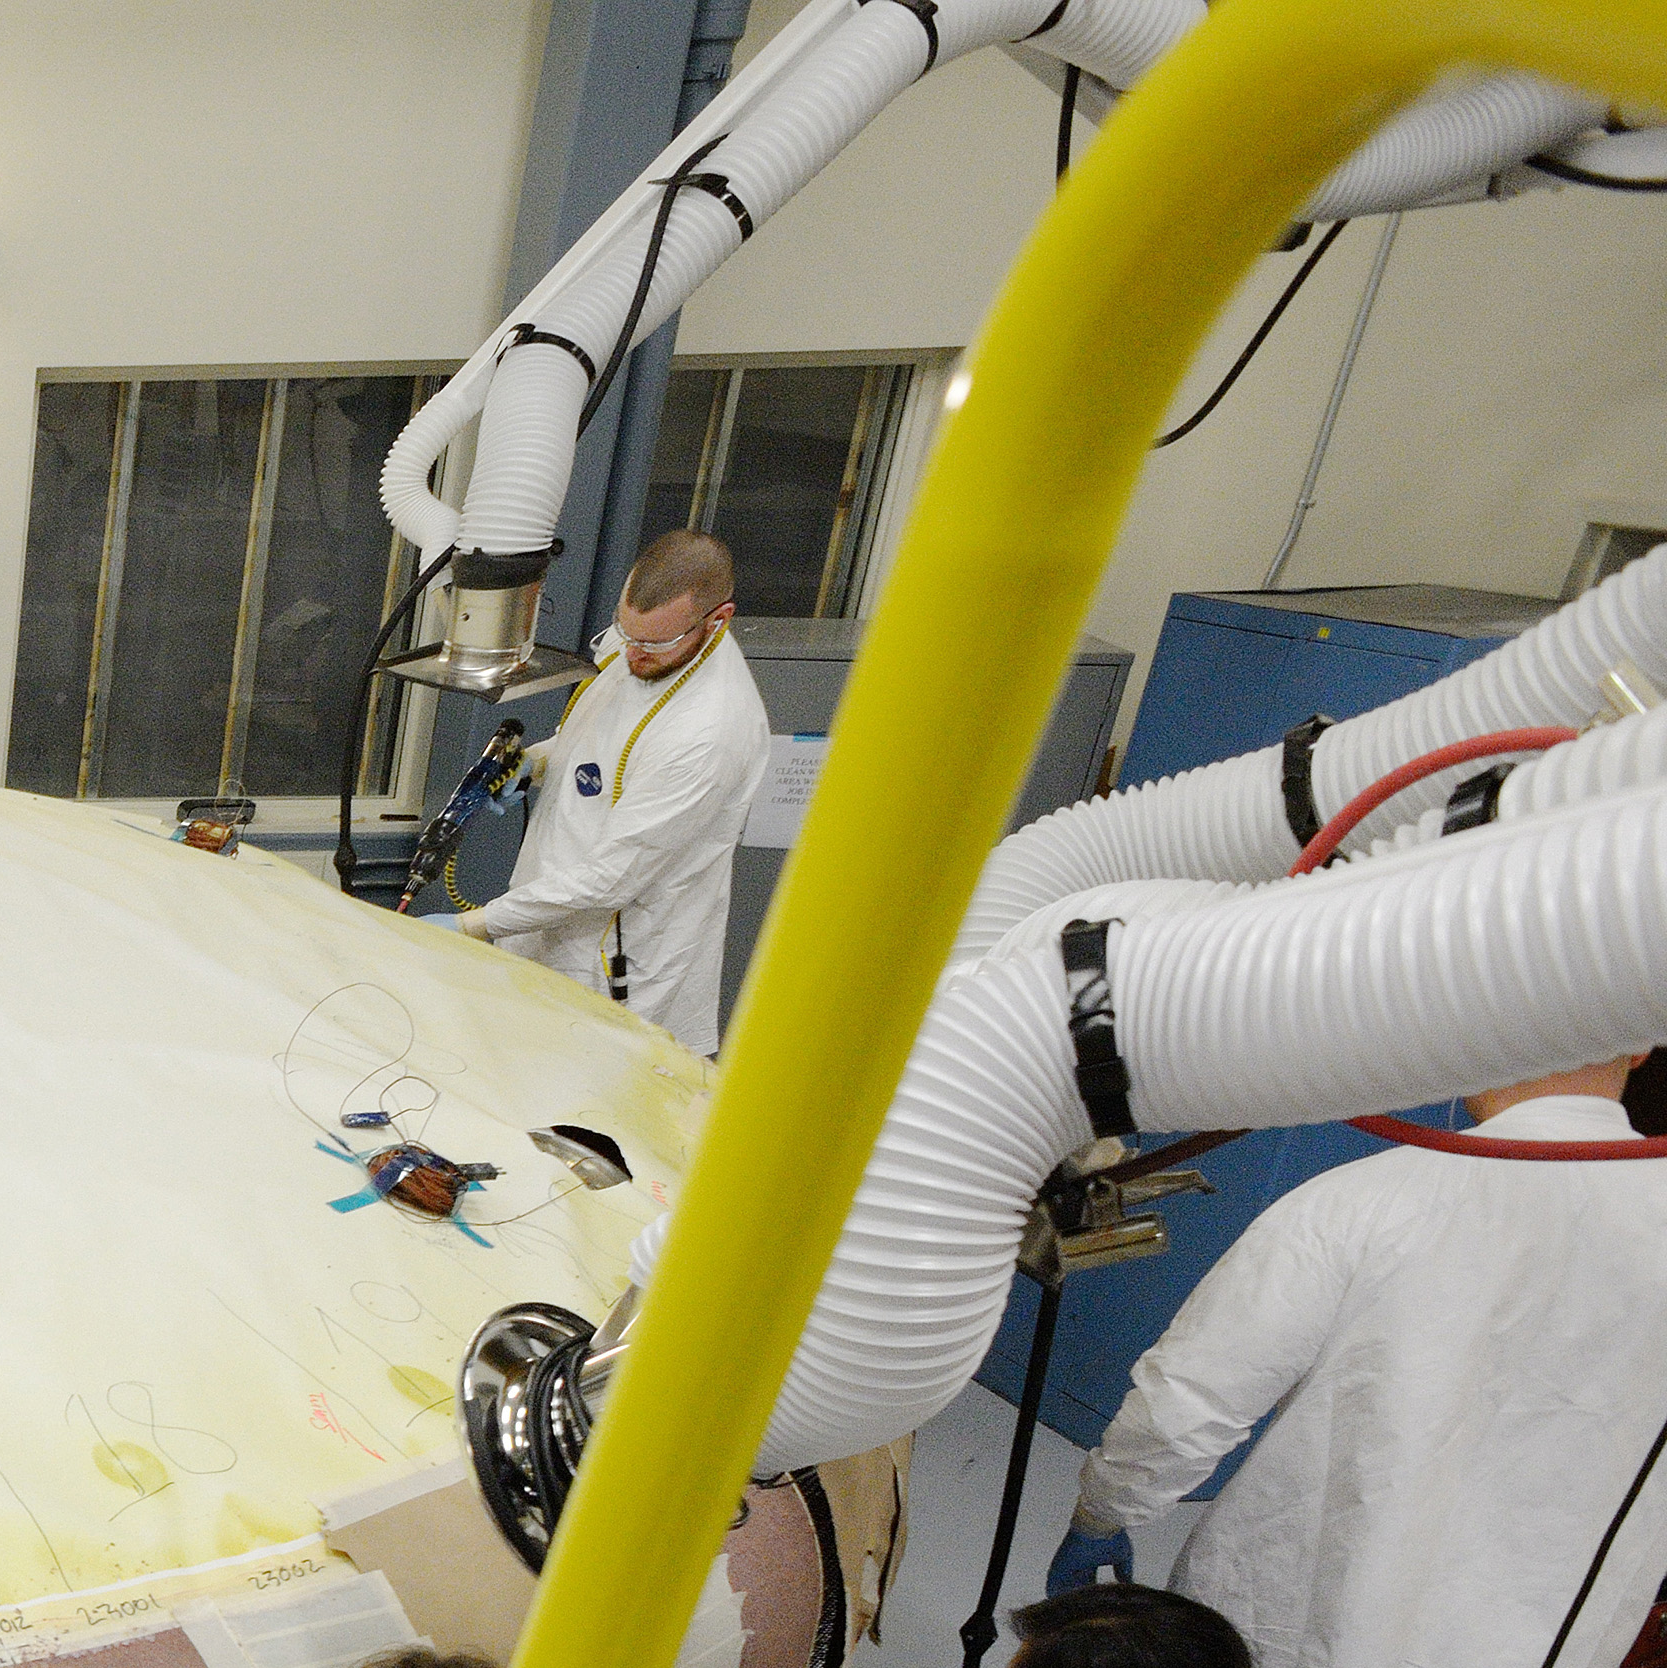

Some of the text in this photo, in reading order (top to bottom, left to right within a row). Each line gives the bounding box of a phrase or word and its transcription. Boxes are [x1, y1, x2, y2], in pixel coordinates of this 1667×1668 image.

[791, 757, 819, 766] PLEAS
[771, 796, 808, 806] COMPLE
[64, 1380, 238, 1522] 18
[248, 1558, 327, 1592] 23002
